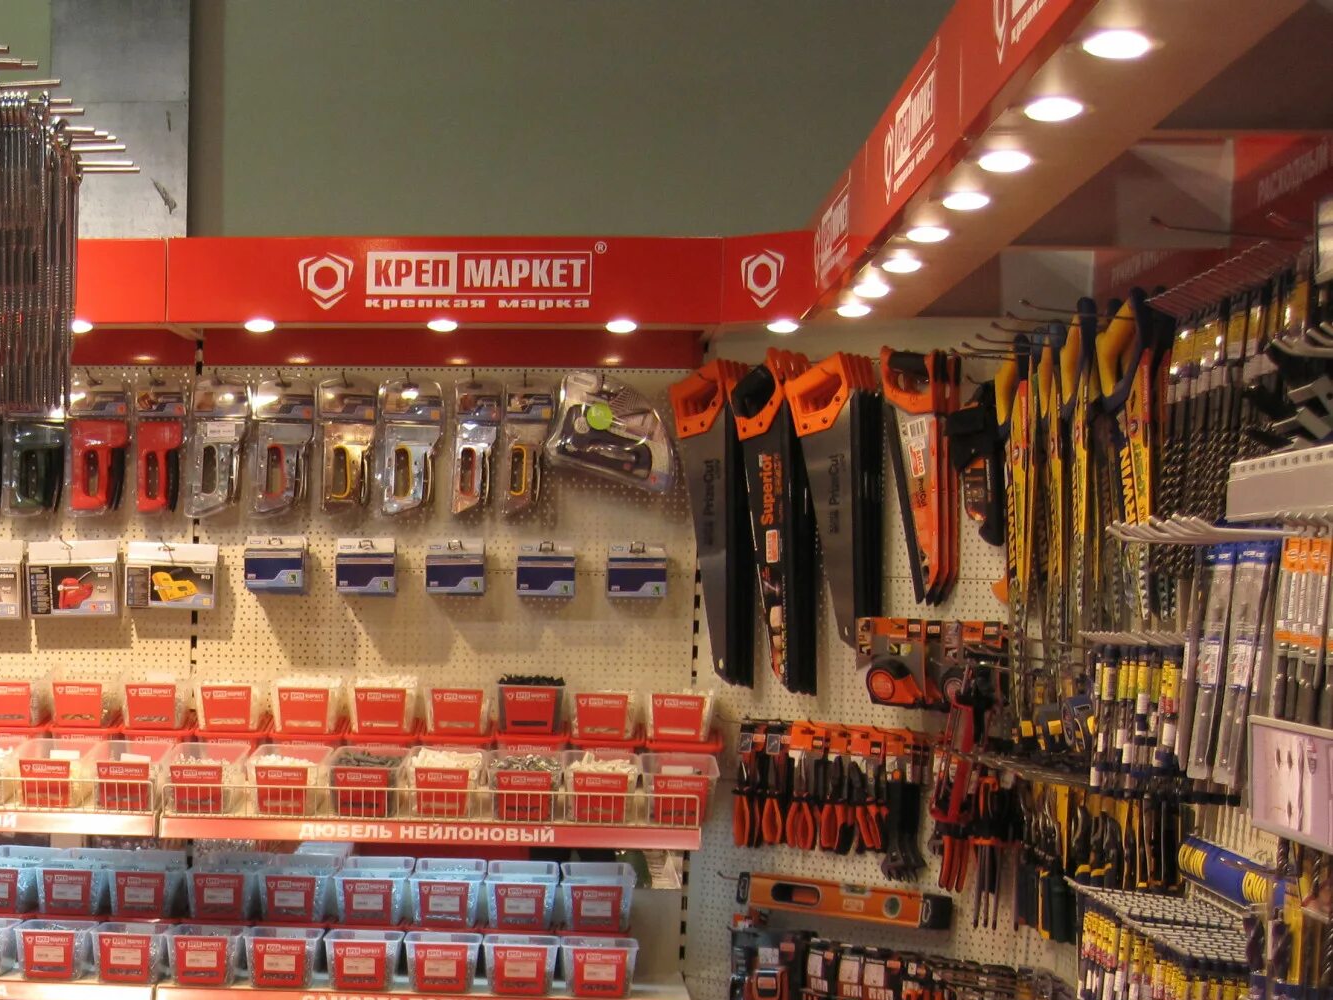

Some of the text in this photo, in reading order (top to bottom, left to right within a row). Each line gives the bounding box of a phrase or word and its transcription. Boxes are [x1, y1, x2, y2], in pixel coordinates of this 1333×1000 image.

[374, 259, 586, 287] КРЕП МАРКЕТ
[365, 297, 590, 310] крепкая марка
[760, 454, 776, 525] Superior
[299, 823, 555, 843] ДЮБЕЛЬ НЕЙЛОНОВЫЙ
